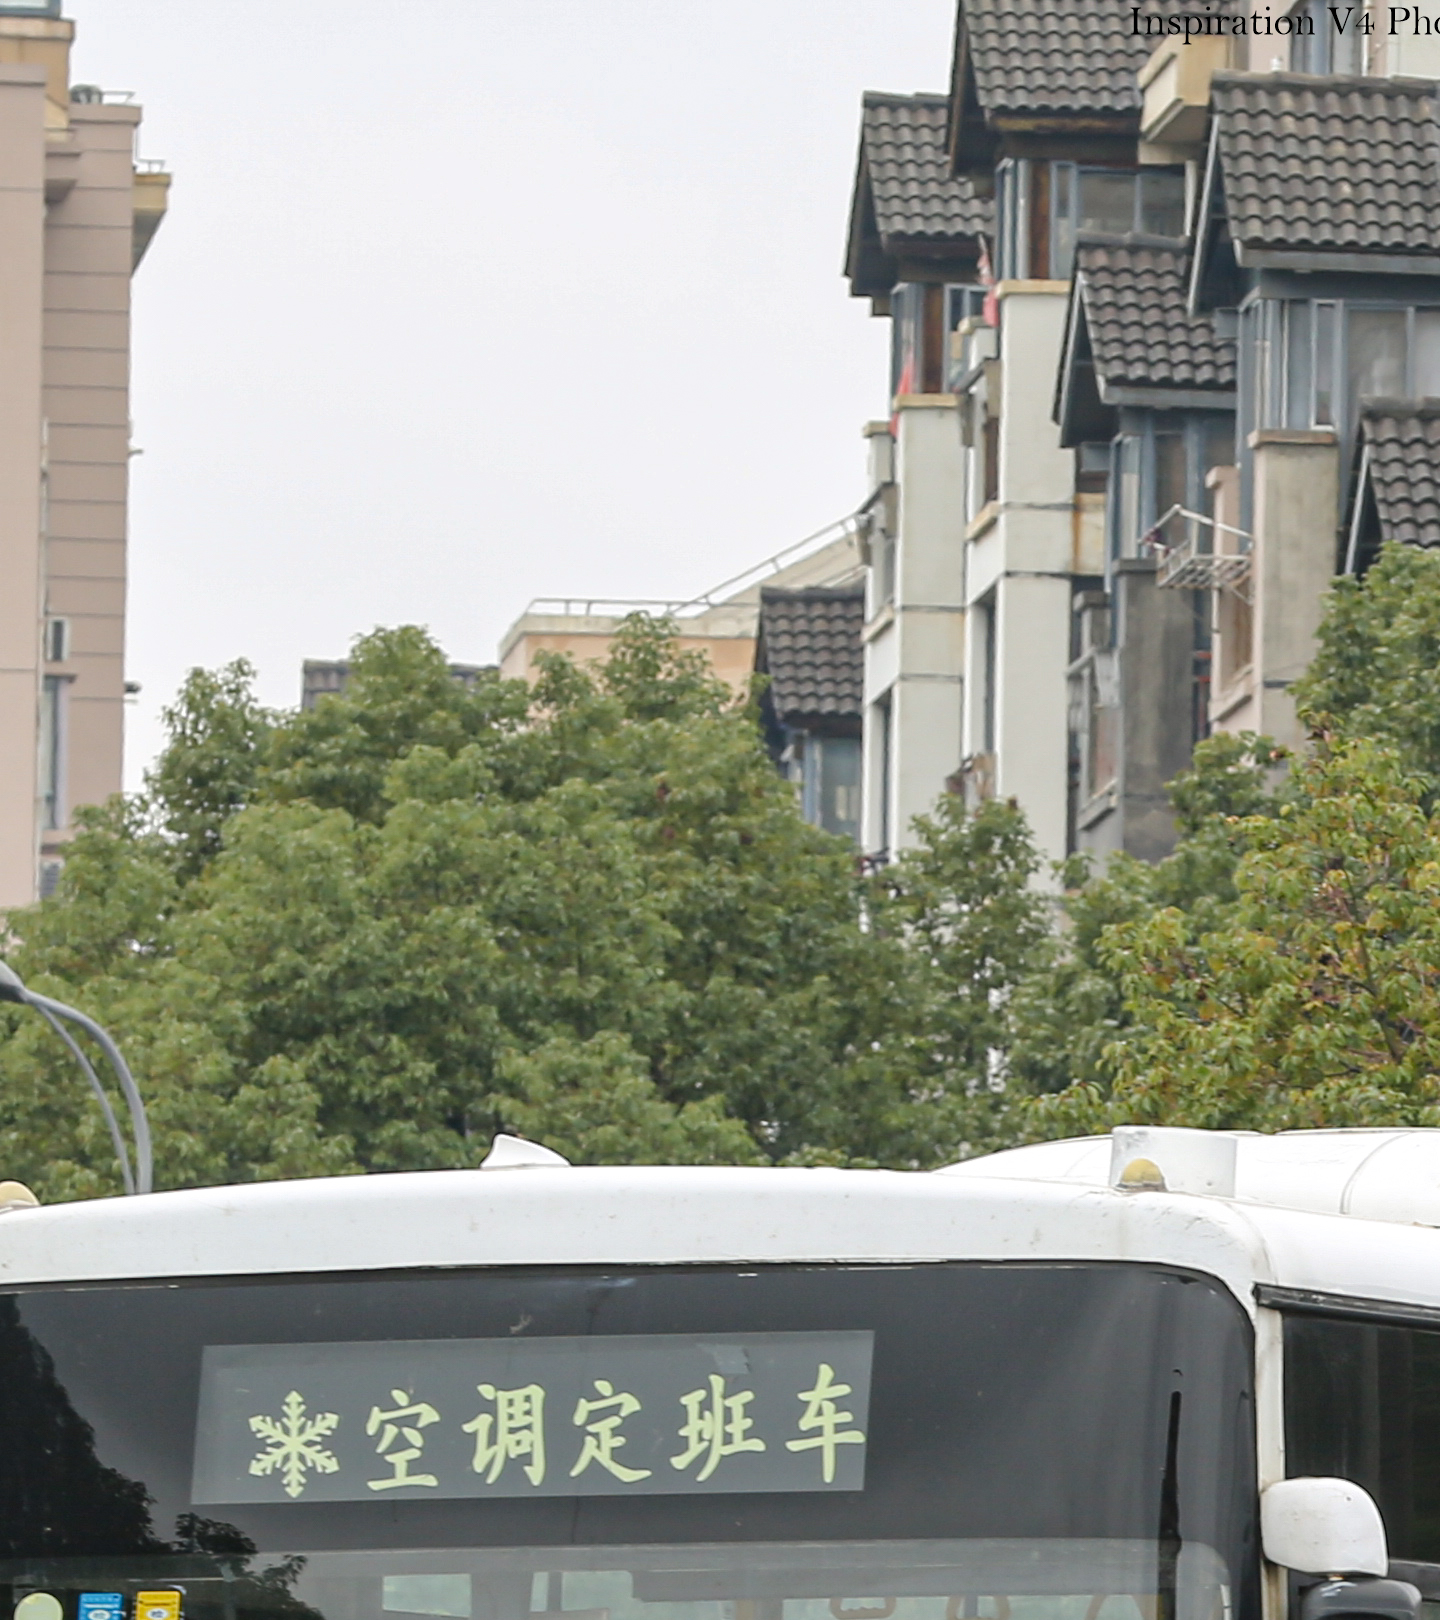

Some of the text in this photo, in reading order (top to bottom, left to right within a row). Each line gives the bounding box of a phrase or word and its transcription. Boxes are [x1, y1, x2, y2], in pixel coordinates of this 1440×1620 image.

[366, 1363, 866, 1491] 空调定班车
